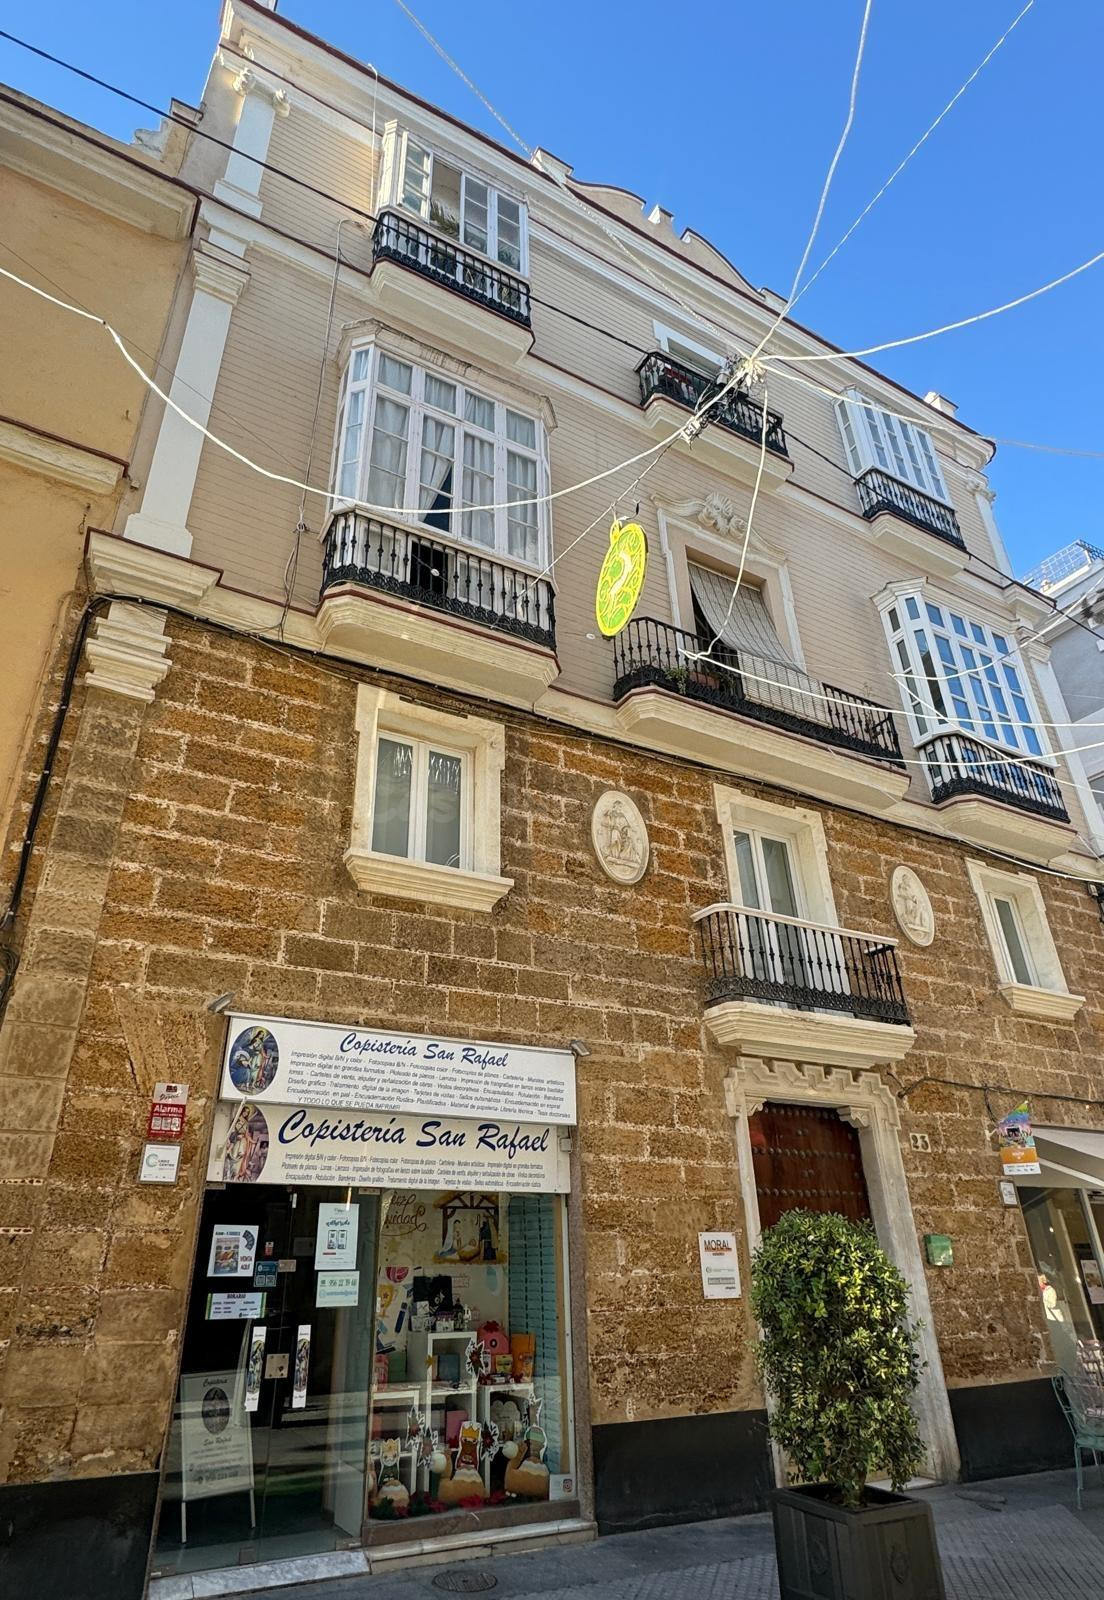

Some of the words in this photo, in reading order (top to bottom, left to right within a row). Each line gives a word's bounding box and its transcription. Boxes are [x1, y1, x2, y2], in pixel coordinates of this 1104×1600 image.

[340, 1032, 417, 1056] Copistería
[423, 1043, 455, 1061] San
[461, 1047, 509, 1070] Rafael
[154, 1104, 183, 1114] Alarma
[278, 1109, 407, 1148] Copistería
[416, 1120, 466, 1147] San
[477, 1123, 551, 1159] Rafael
[703, 1239, 732, 1251] MORAL
